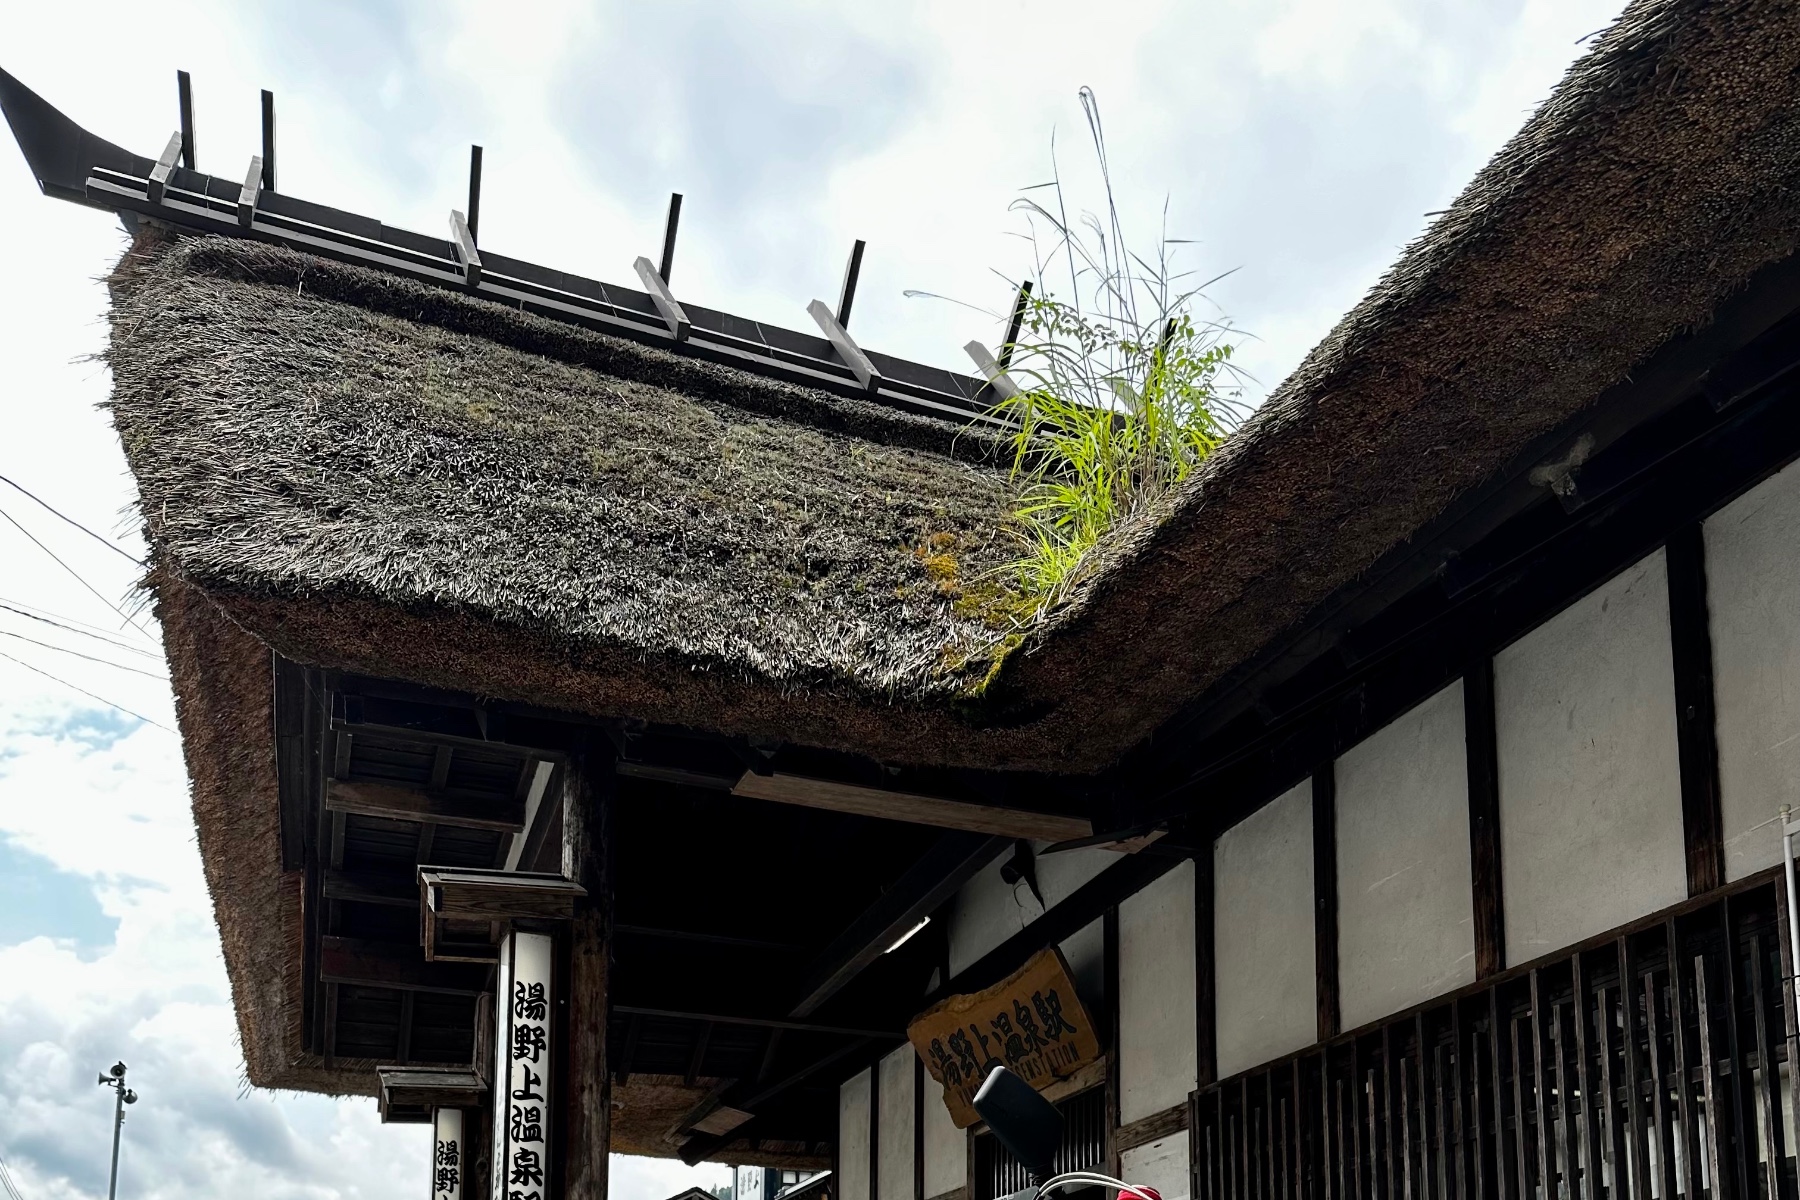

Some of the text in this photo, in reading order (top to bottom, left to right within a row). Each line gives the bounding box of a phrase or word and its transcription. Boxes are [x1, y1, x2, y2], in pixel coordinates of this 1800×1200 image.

[928, 988, 1078, 1092] 湯野上温泉駅
